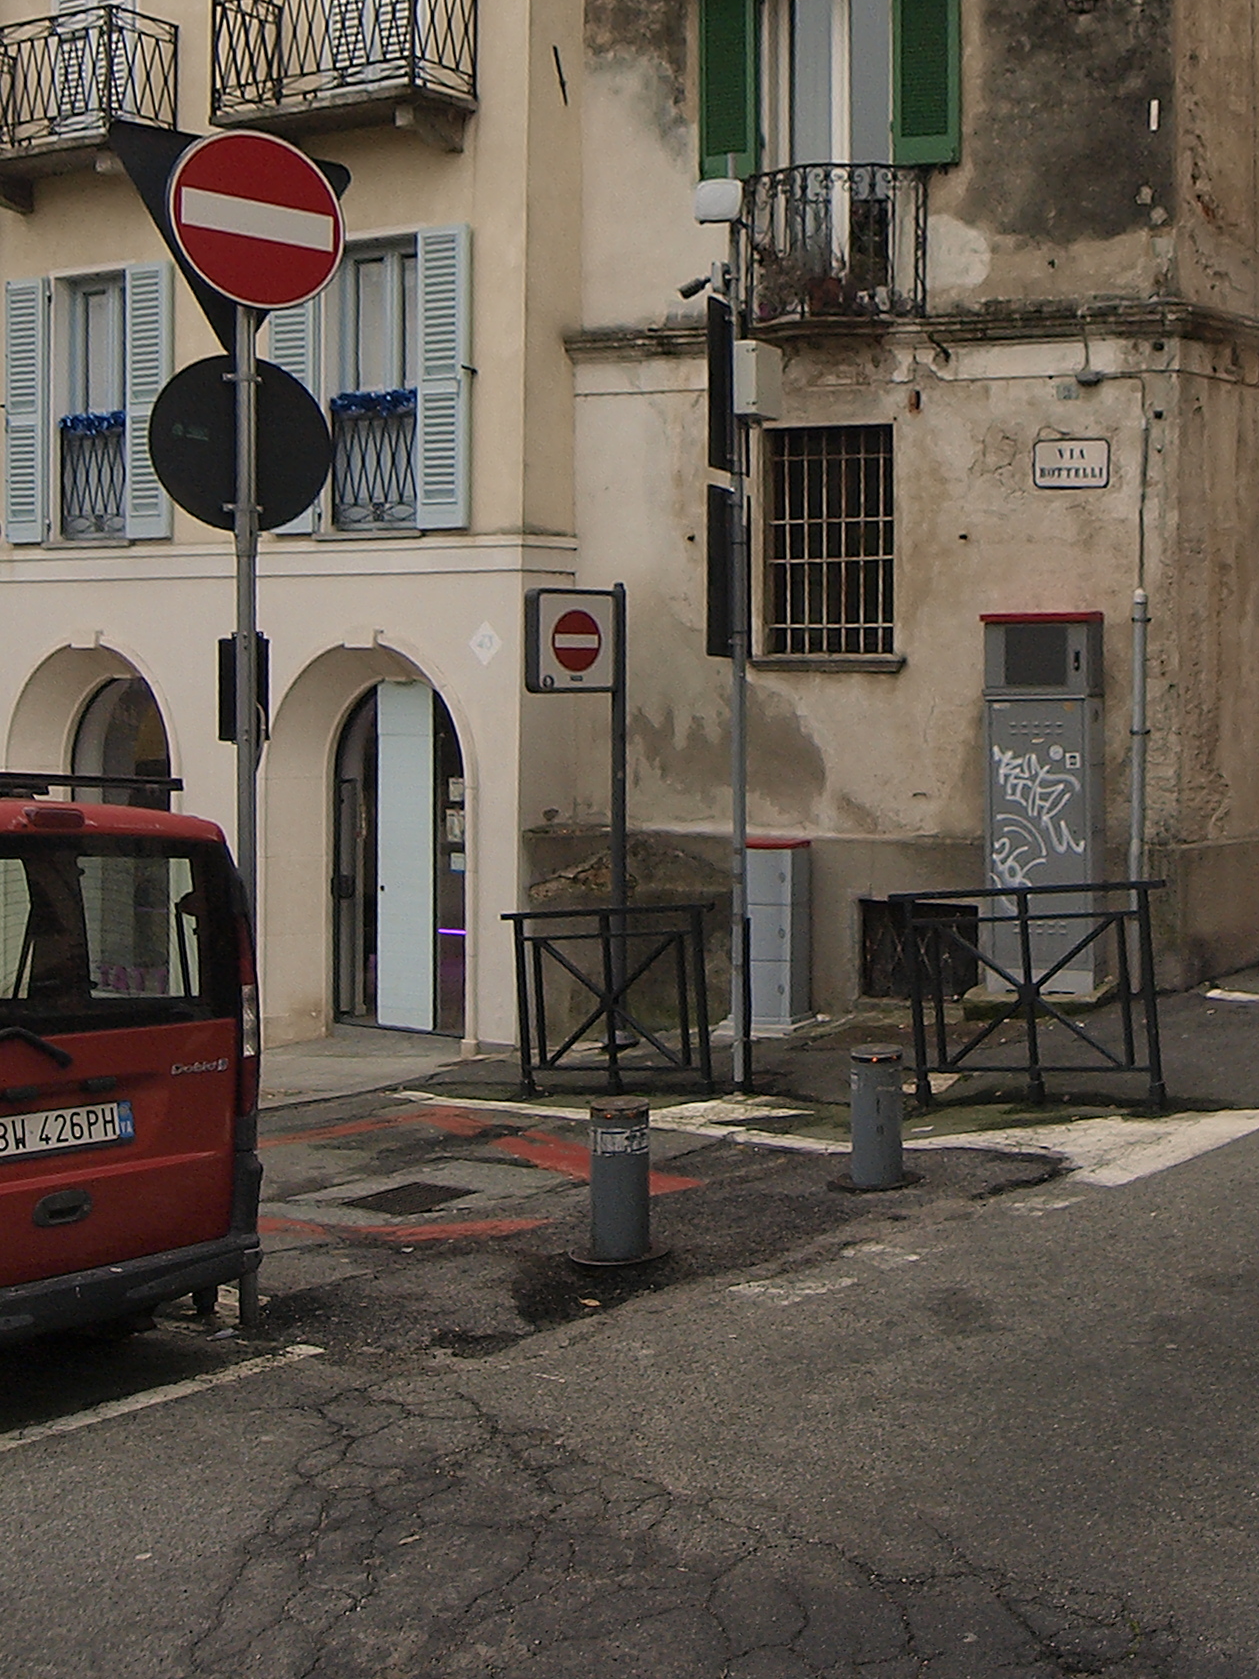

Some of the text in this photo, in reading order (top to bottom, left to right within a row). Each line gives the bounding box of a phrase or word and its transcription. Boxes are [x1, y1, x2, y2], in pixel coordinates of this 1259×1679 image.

[1057, 447, 1086, 460] VIA
[1039, 467, 1104, 479] BOTTELLI
[39, 1107, 117, 1145] 426PH
